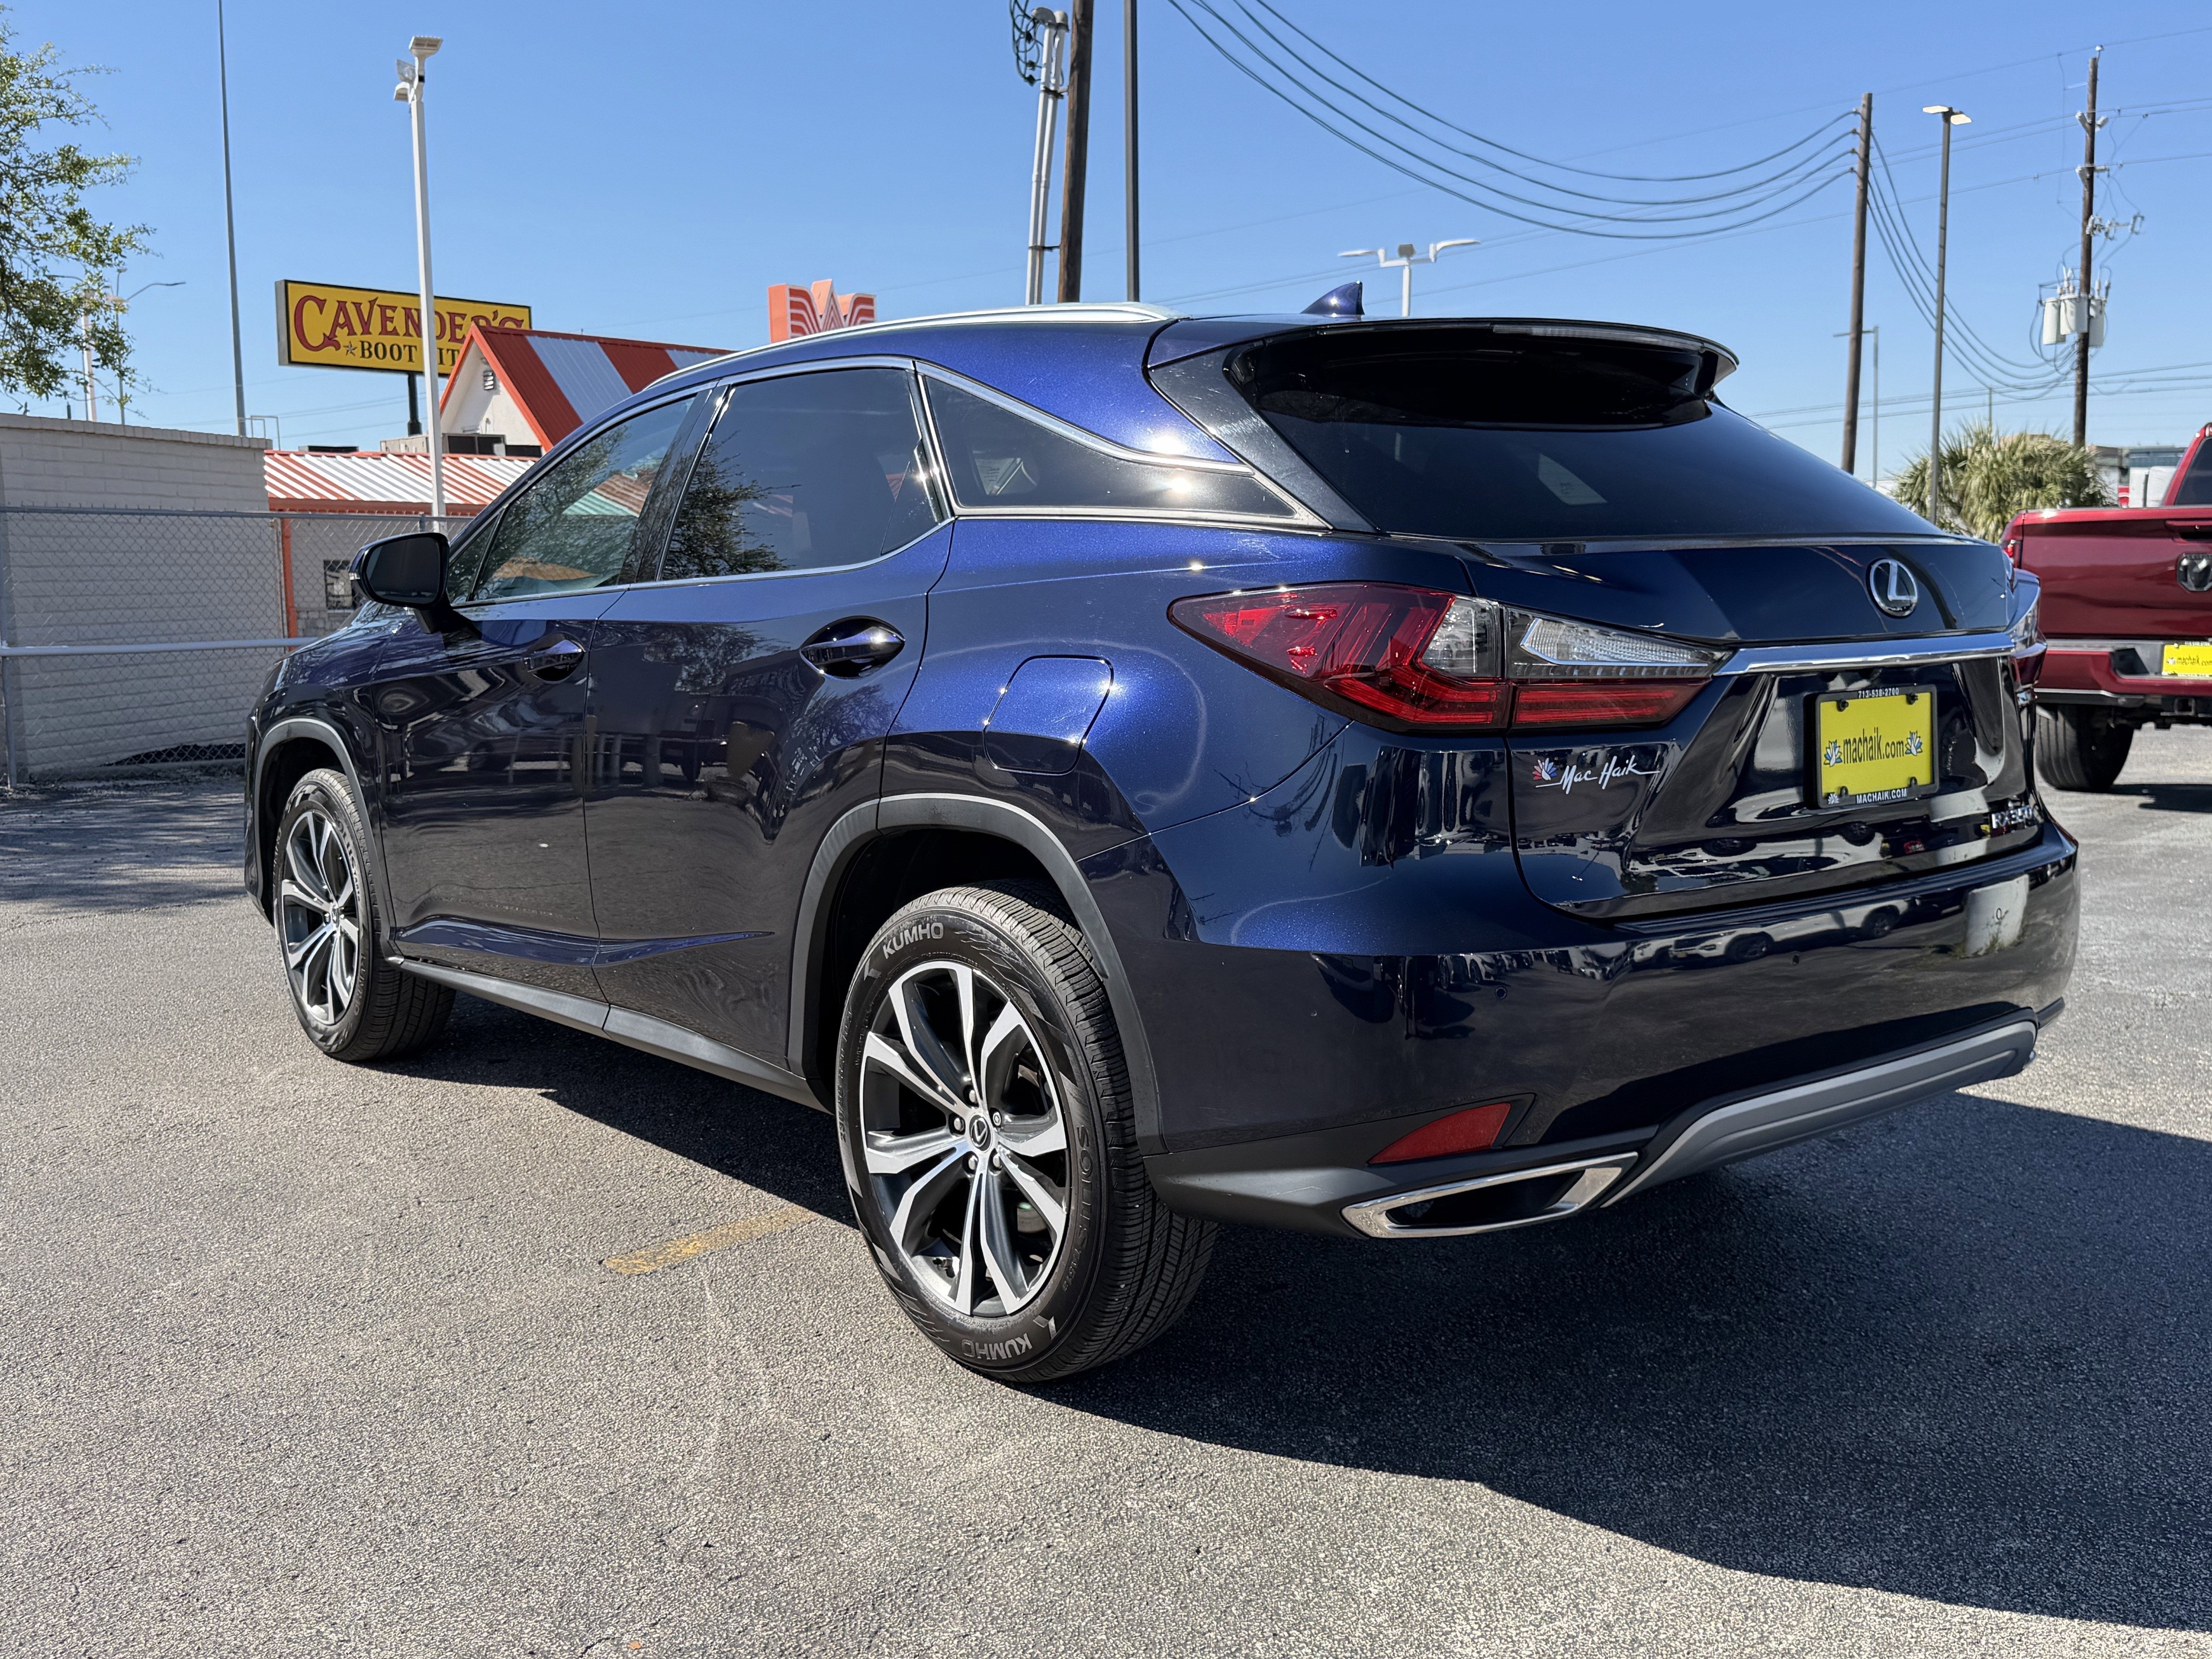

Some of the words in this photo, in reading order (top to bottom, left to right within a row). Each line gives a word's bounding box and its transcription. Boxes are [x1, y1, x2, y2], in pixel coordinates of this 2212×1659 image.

[360, 340, 418, 363] BOOT
[1843, 726, 1904, 764] machaik.com
[1535, 765, 1599, 795] Mac
[1598, 755, 1661, 790] Haik
[1856, 788, 1907, 804] MACHAIK.COM
[883, 922, 944, 959] KUMHO
[961, 1333, 1033, 1360] KUMHO
